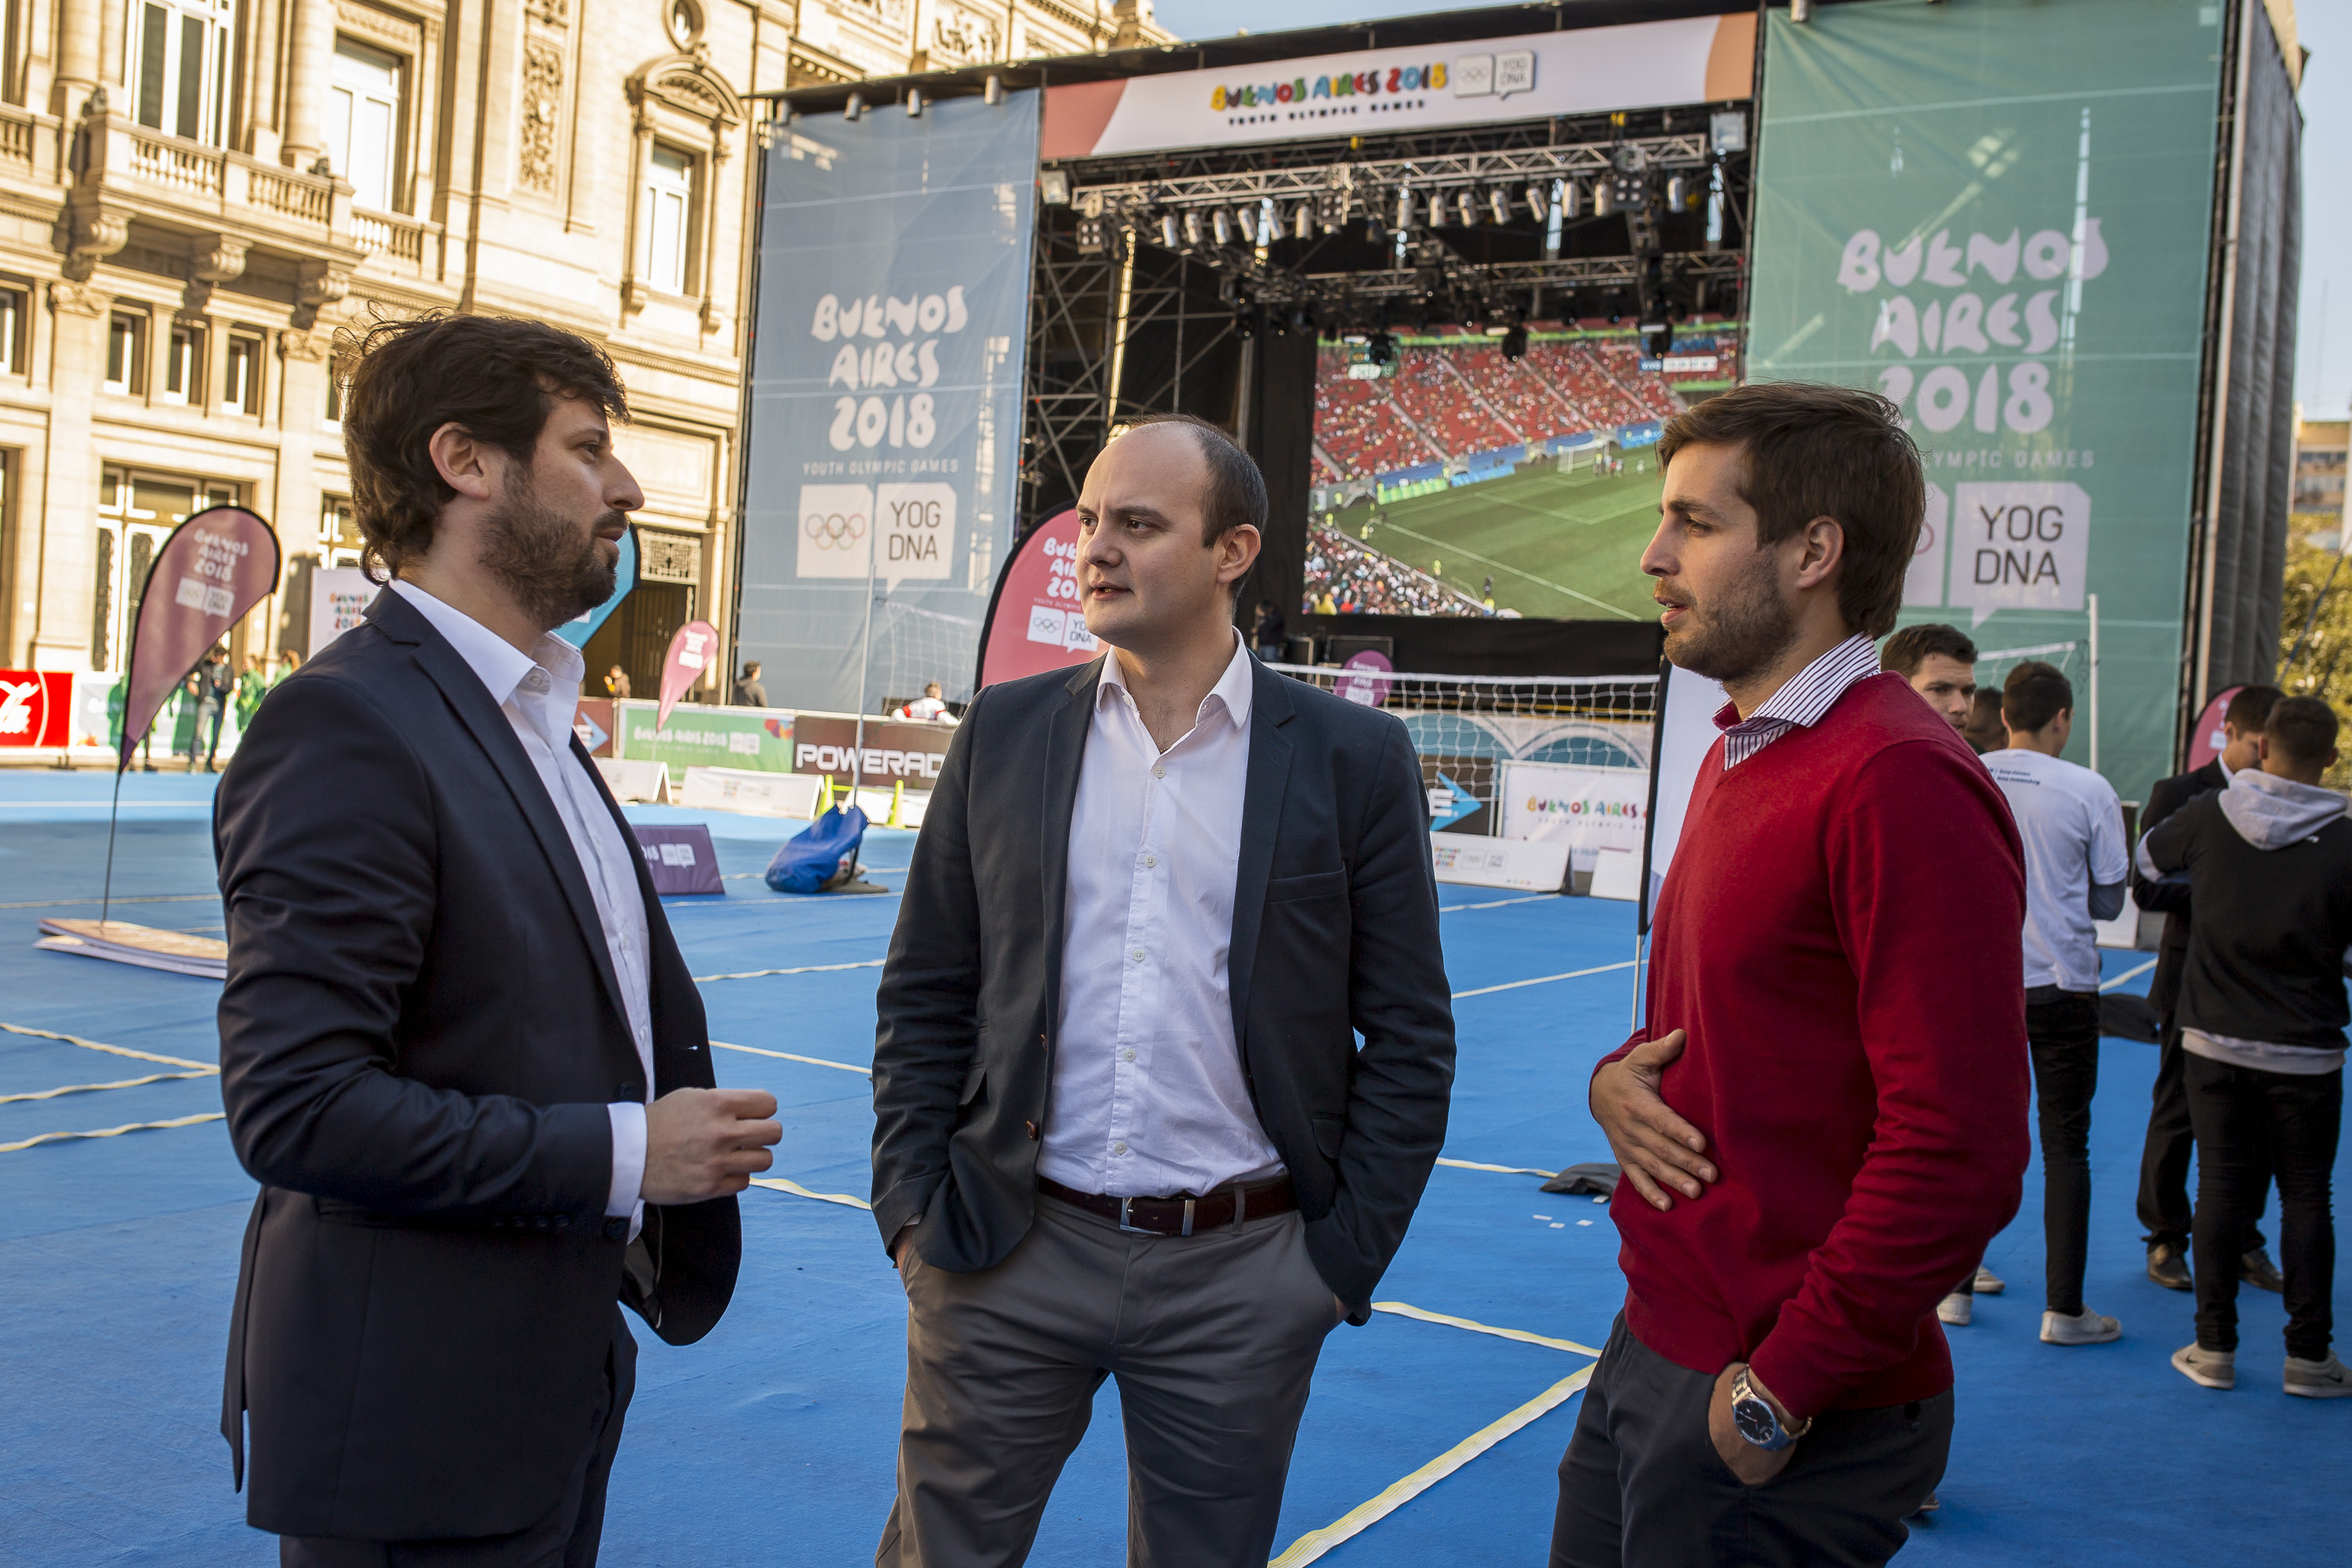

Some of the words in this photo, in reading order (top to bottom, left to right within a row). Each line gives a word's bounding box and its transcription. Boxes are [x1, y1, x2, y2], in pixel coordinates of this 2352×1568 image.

[1210, 77, 1306, 111] BUENOS
[1312, 71, 1380, 100] AIRES
[1386, 62, 1447, 93] 2018
[1835, 217, 2111, 293] BUENOS
[810, 285, 969, 343] BUENOS
[1869, 289, 2060, 358] AIRES
[828, 339, 940, 392] AIRES
[1877, 360, 2055, 435] 2018
[828, 392, 937, 452] 2018
[802, 460, 845, 477] YOUTH
[848, 459, 906, 476] OLYMPIC
[910, 457, 960, 474] GAMES
[1922, 449, 2002, 469] YMPIC
[2014, 448, 2095, 469] GAMES
[890, 499, 942, 529] YOG
[1979, 503, 2064, 543] YOG
[887, 533, 939, 561] DNA
[1973, 548, 2060, 586] DNA
[1526, 795, 1590, 815] BUENOS
[1595, 800, 1638, 818] AIRES
